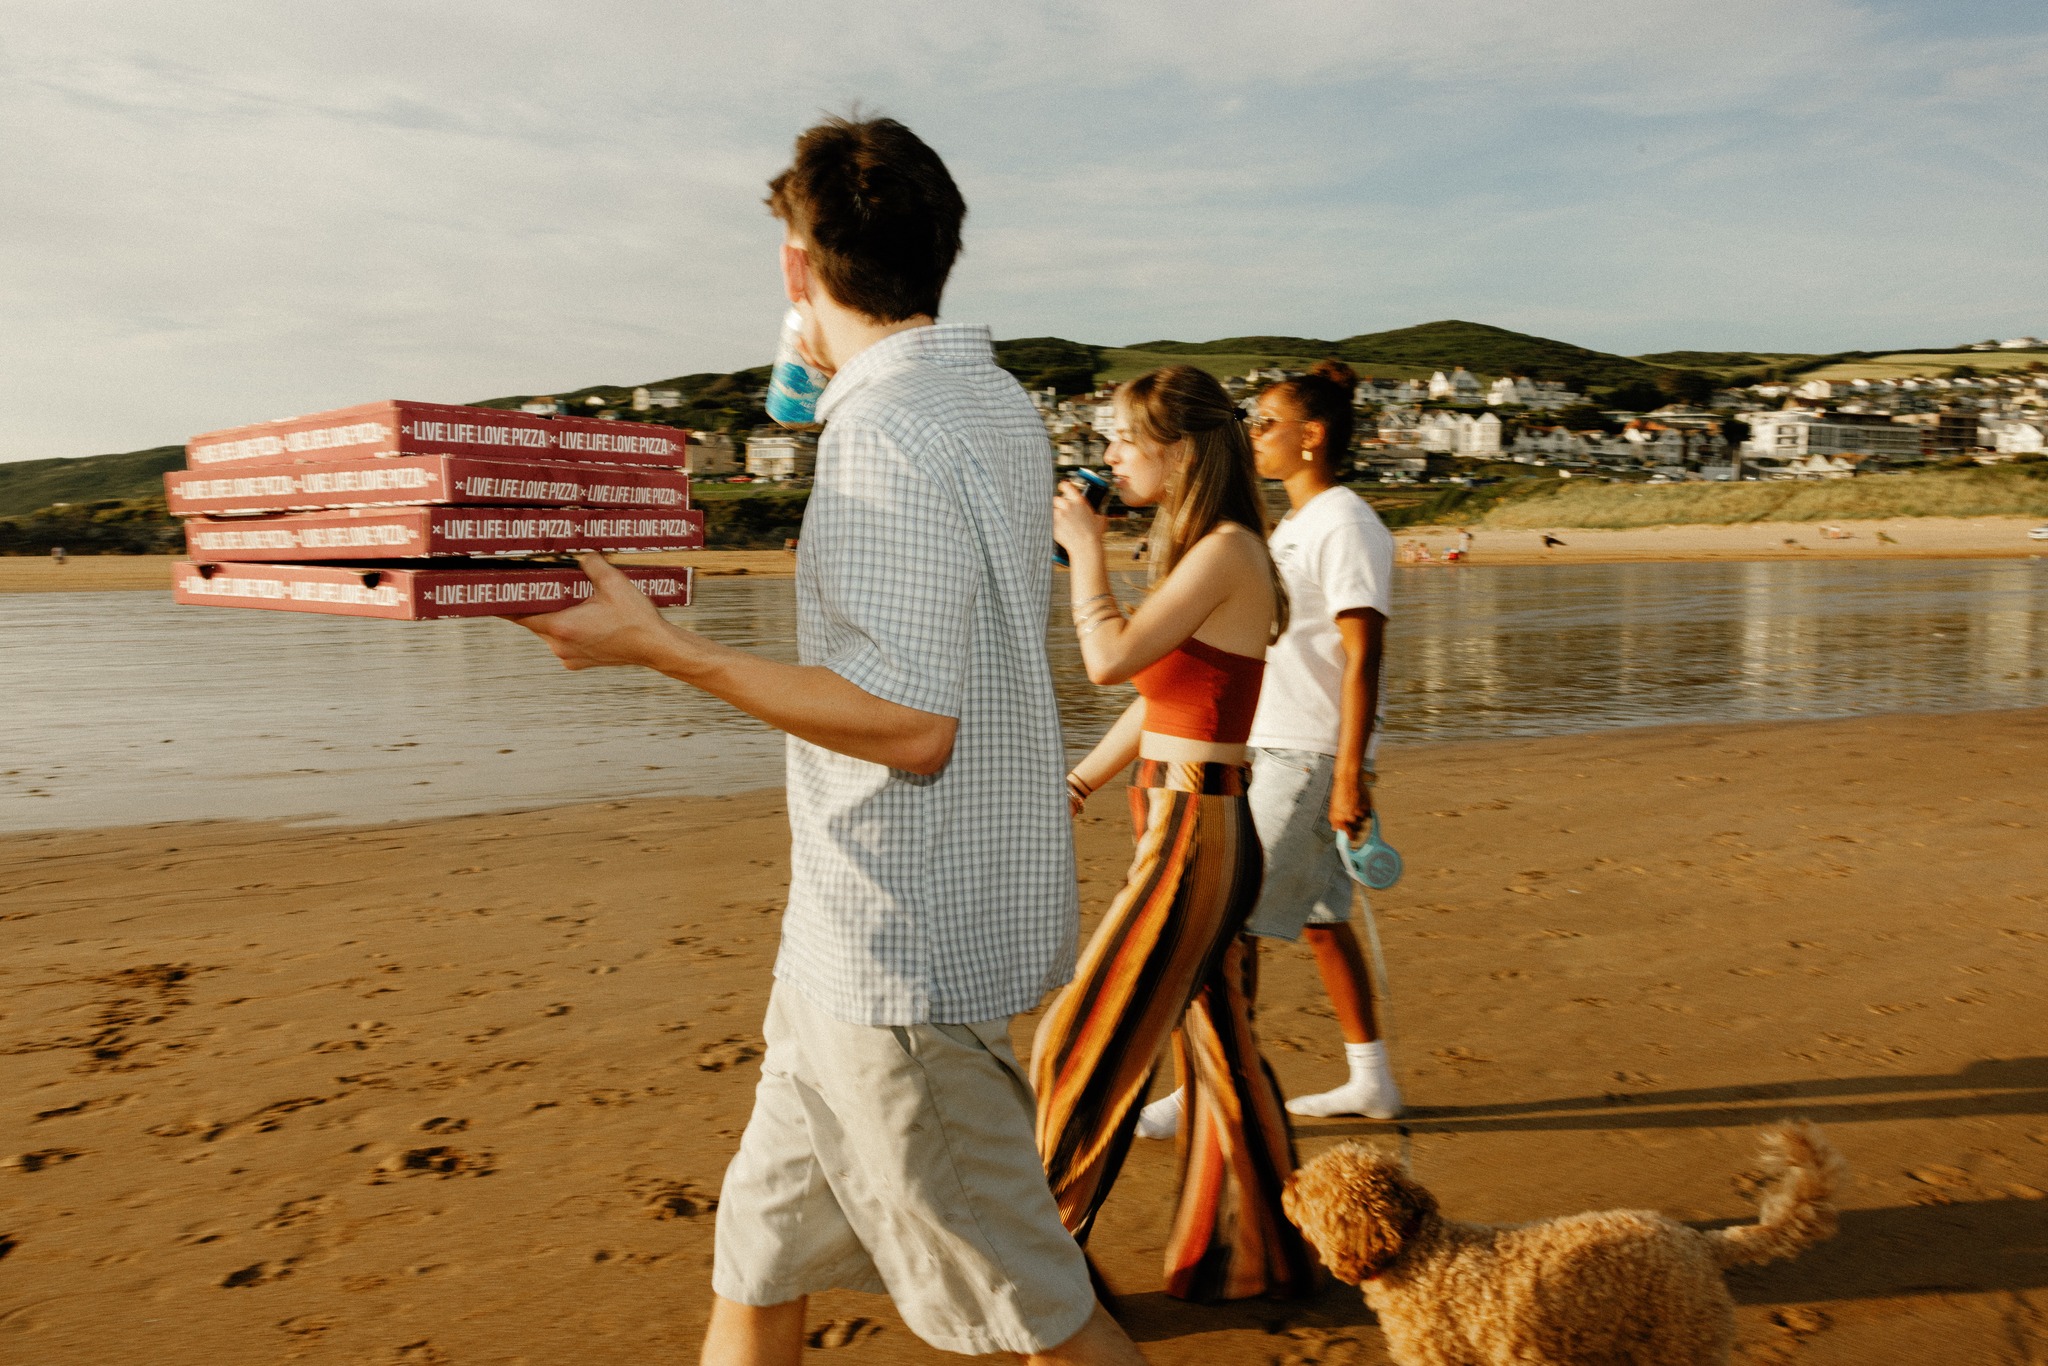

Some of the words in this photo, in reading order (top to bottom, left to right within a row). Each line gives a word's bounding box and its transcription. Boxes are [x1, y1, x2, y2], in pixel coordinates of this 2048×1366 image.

[414, 420, 443, 442] LIVE
[447, 423, 474, 443] LIFE
[478, 425, 509, 446] LOVE
[512, 428, 546, 448] PIZZA
[560, 431, 583, 450] LIVE
[587, 433, 609, 451] LIFE
[611, 435, 637, 453] LOVE
[640, 437, 668, 455] PIZZA
[466, 476, 493, 496] LIVE
[494, 478, 518, 498] LIFE
[520, 480, 548, 500] LOVE
[549, 482, 578, 501] PIZZA
[588, 484, 609, 502] LIVE
[610, 486, 629, 502] LIFE
[630, 487, 652, 504] LOVE
[653, 488, 675, 505] PIZZA
[444, 519, 473, 539] LIVE
[476, 519, 503, 538] LIFE
[506, 519, 536, 538] LOVE
[539, 519, 571, 538] PIZZA
[584, 519, 607, 537] LIVE
[610, 519, 632, 537] LIFE
[634, 519, 658, 536] LOVE
[660, 519, 687, 536] PIZZA
[436, 584, 464, 605] LIVE
[467, 584, 493, 603] LIFE
[496, 583, 525, 601] LOVE
[528, 581, 560, 600] PIZZA
[649, 579, 676, 596] PIZZA
